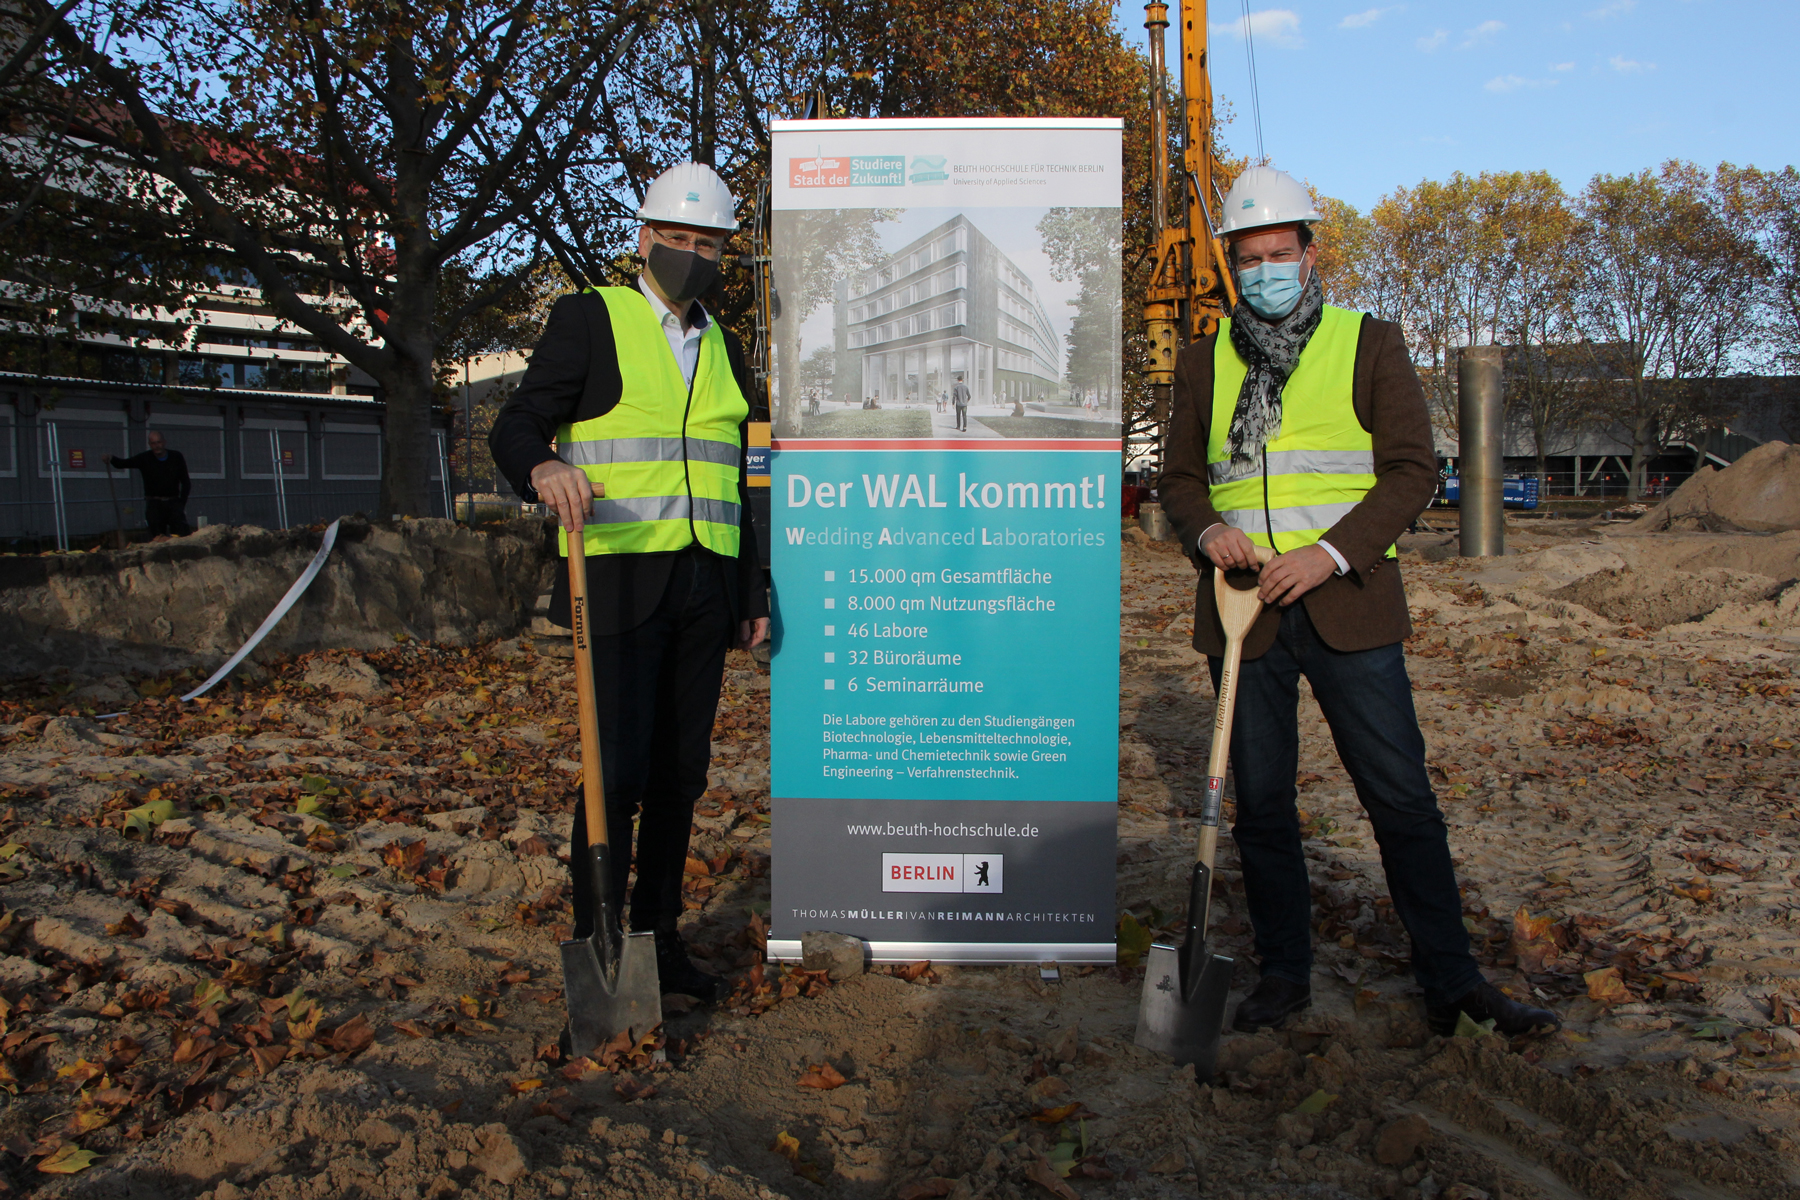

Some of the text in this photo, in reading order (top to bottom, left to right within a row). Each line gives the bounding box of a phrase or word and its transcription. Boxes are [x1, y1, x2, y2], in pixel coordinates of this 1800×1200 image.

[851, 158, 902, 170] Studiere
[954, 165, 977, 173] BEUTH
[980, 165, 1028, 173] HOCHSCHULE
[1031, 164, 1044, 172] FÜR
[794, 172, 902, 186] Stadt der Zukunft!
[954, 178, 984, 186] University
[993, 178, 1017, 186] Applied
[788, 473, 1105, 508] Der WAL kommt!
[785, 527, 1104, 549] Wedding Advanced Laboratories
[849, 568, 1052, 587] 15.000 qm Gesamtfläche
[848, 596, 1055, 614] 8.000 qm Nutzungsfläche
[575, 596, 587, 651] Format
[848, 622, 928, 638] 46 Labore
[849, 650, 961, 665] 32 Büroräume
[848, 677, 983, 692] 6 Seminarräume
[1216, 671, 1231, 731] Idealspaten
[824, 714, 1075, 729] Die Labore gehören zu den Studiengängen
[824, 731, 1071, 747] Biotechnologie, Lebensmitteltechnologie,
[824, 748, 1066, 761] Pharma- und Chemietechnik sowie Green
[824, 766, 893, 780] Engineering
[907, 767, 1018, 778] Verfahrenstechnik.
[848, 822, 1038, 837] www.beuth-hochschule.de
[892, 866, 954, 880] BERLIN
